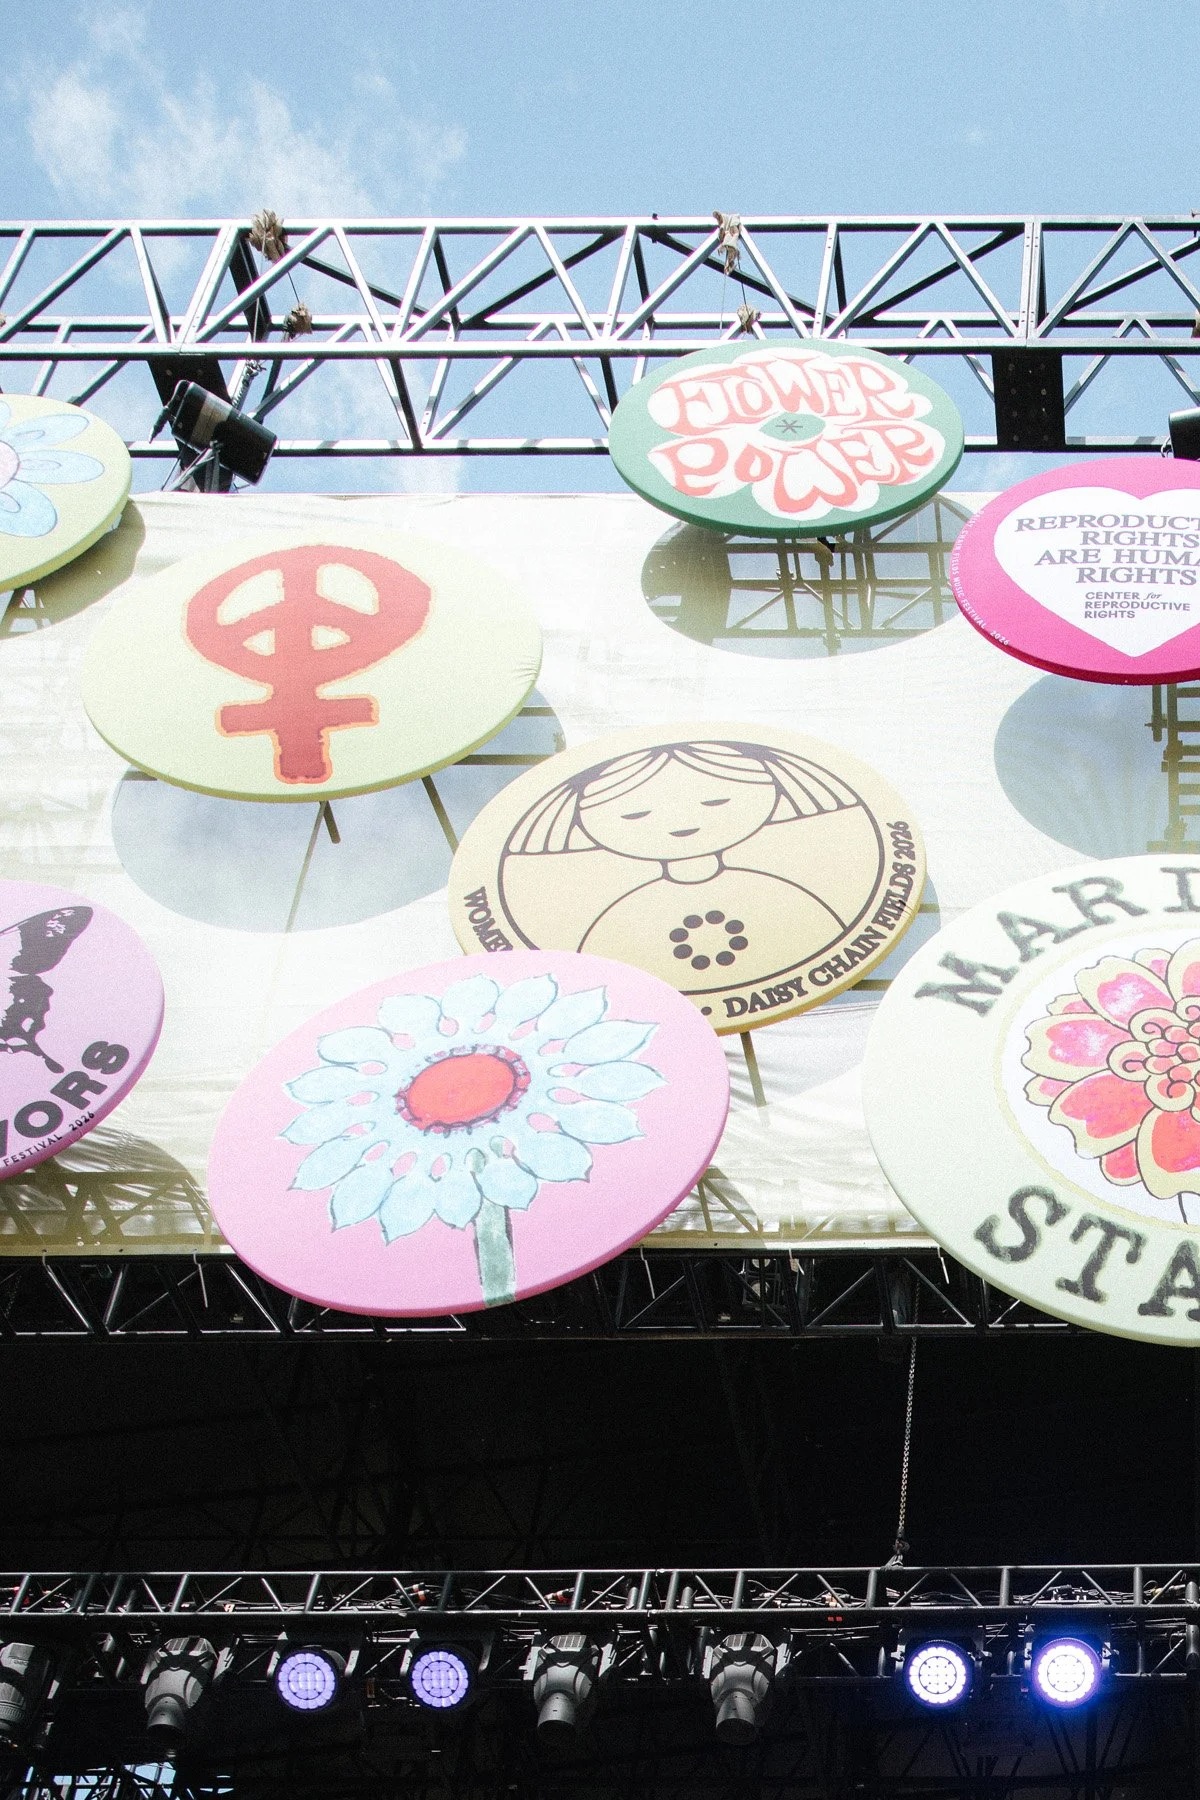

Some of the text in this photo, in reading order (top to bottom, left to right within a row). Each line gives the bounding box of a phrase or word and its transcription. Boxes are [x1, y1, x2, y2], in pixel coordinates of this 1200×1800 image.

[655, 357, 915, 436] FLOWER
[648, 424, 935, 513] POWER
[1034, 548, 1100, 566] ARE
[1079, 530, 1200, 549] RIGHTS
[1075, 567, 1197, 586] RIGHTS
[1085, 592, 1162, 600] CENTER for
[953, 578, 965, 598] MUSIC
[961, 598, 988, 630] FESTIVAL
[989, 630, 1011, 646] 2026
[1084, 601, 1190, 611] REPRODUCTIVE
[1084, 610, 1135, 619] RIGHTS
[886, 820, 916, 860] 2026
[871, 861, 916, 931] FIELDS
[808, 925, 887, 986] CHAIN
[722, 976, 808, 1018] DAISY
[3, 1111, 95, 1166] FESTIVAL 2026
